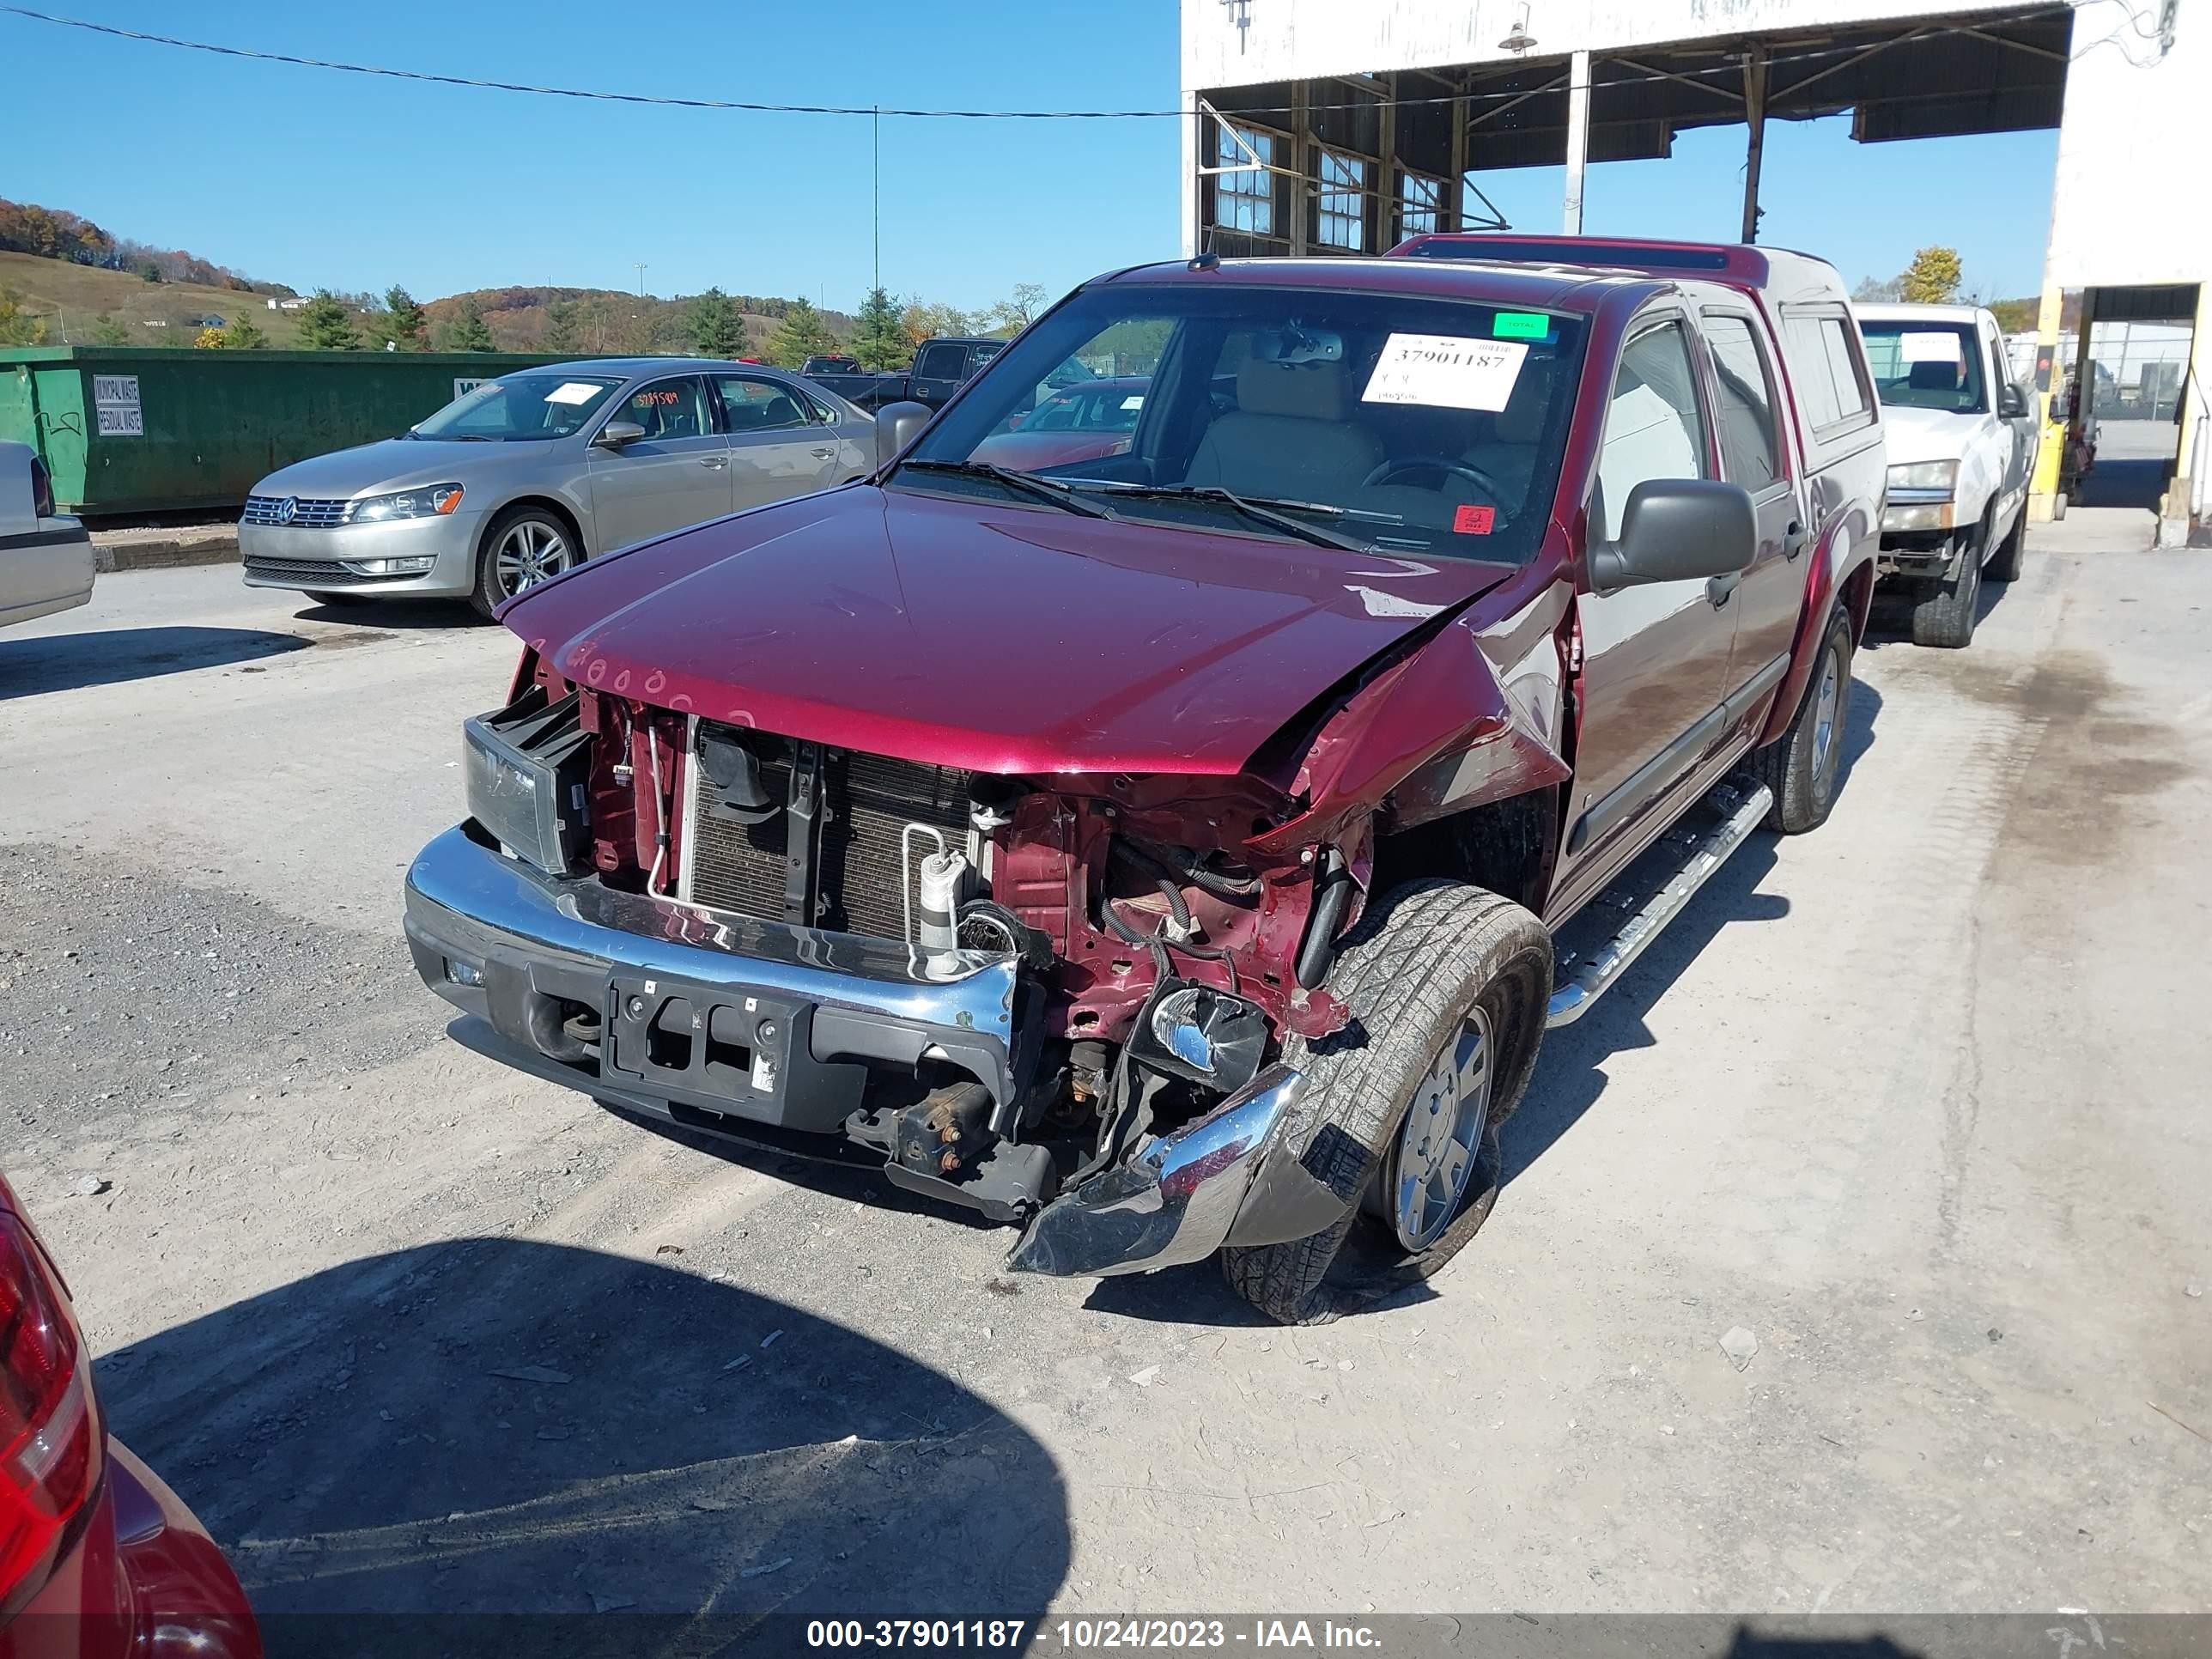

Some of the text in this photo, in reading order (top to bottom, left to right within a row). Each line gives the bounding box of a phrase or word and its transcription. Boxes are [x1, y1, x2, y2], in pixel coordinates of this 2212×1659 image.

[1395, 349, 1505, 368] 37901187
[96, 380, 137, 400] MUNICIPAL WASTE
[99, 410, 124, 430] RESIDUAL
[122, 411, 140, 430] WASTE
